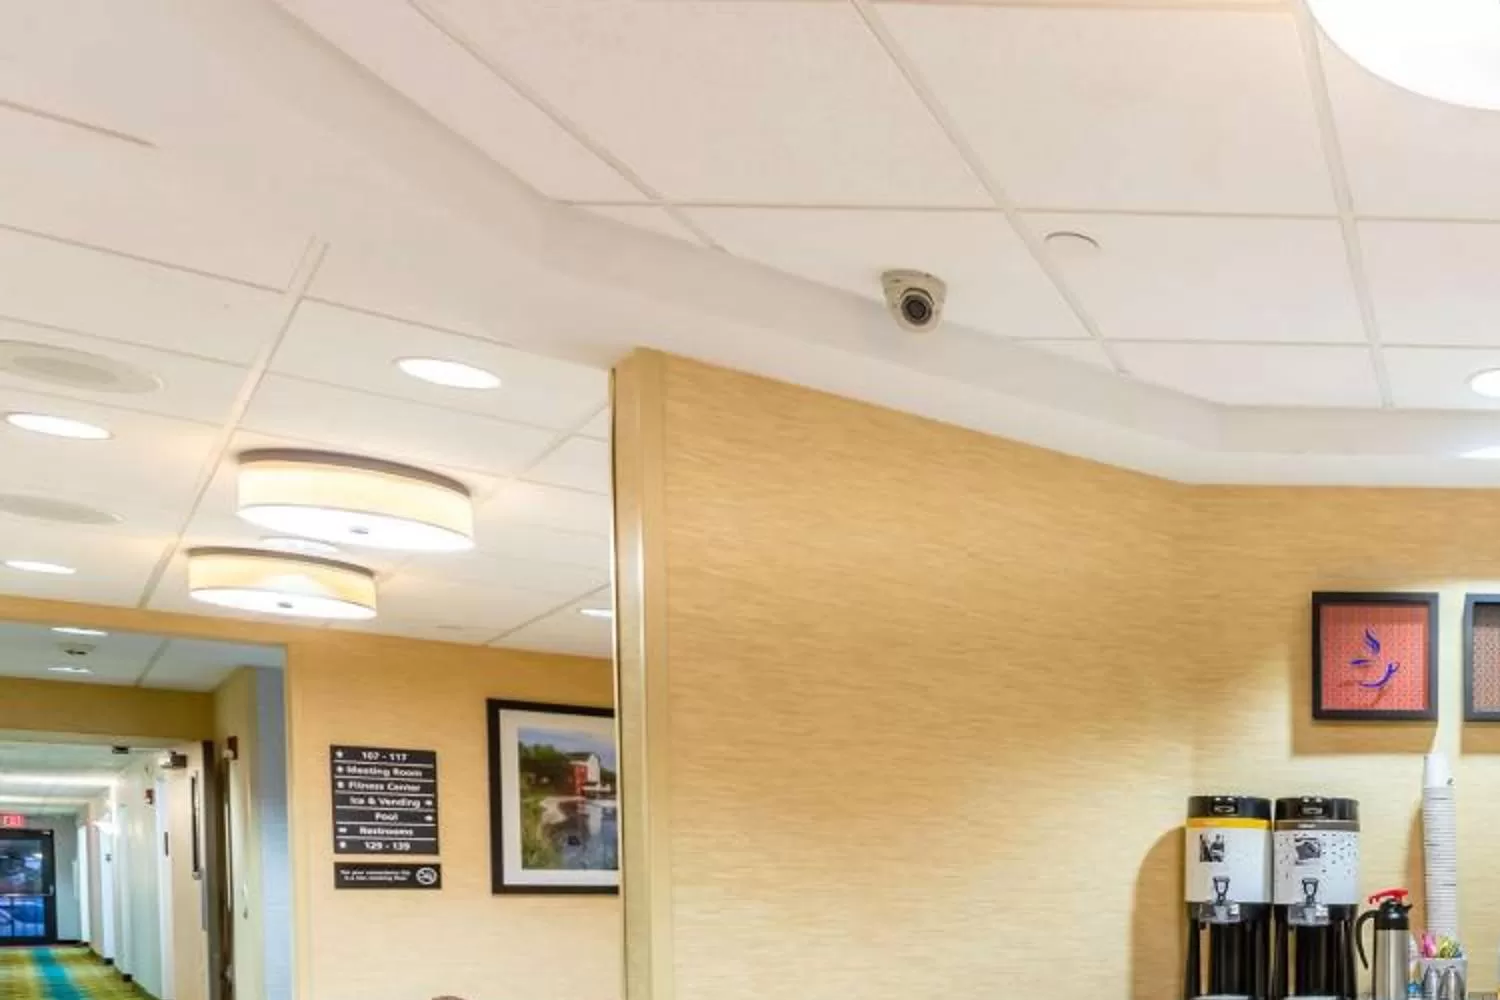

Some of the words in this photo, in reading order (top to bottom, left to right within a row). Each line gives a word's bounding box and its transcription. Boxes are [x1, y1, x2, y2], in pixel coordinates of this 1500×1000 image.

[346, 765, 390, 777] Meeting
[392, 767, 422, 777] Room
[348, 781, 385, 791] Fitness
[387, 782, 421, 792] Center
[349, 796, 365, 805] Ice
[367, 796, 376, 805] &
[377, 797, 421, 809] Vending
[375, 811, 399, 821] Pool
[359, 826, 414, 836] Restrooms
